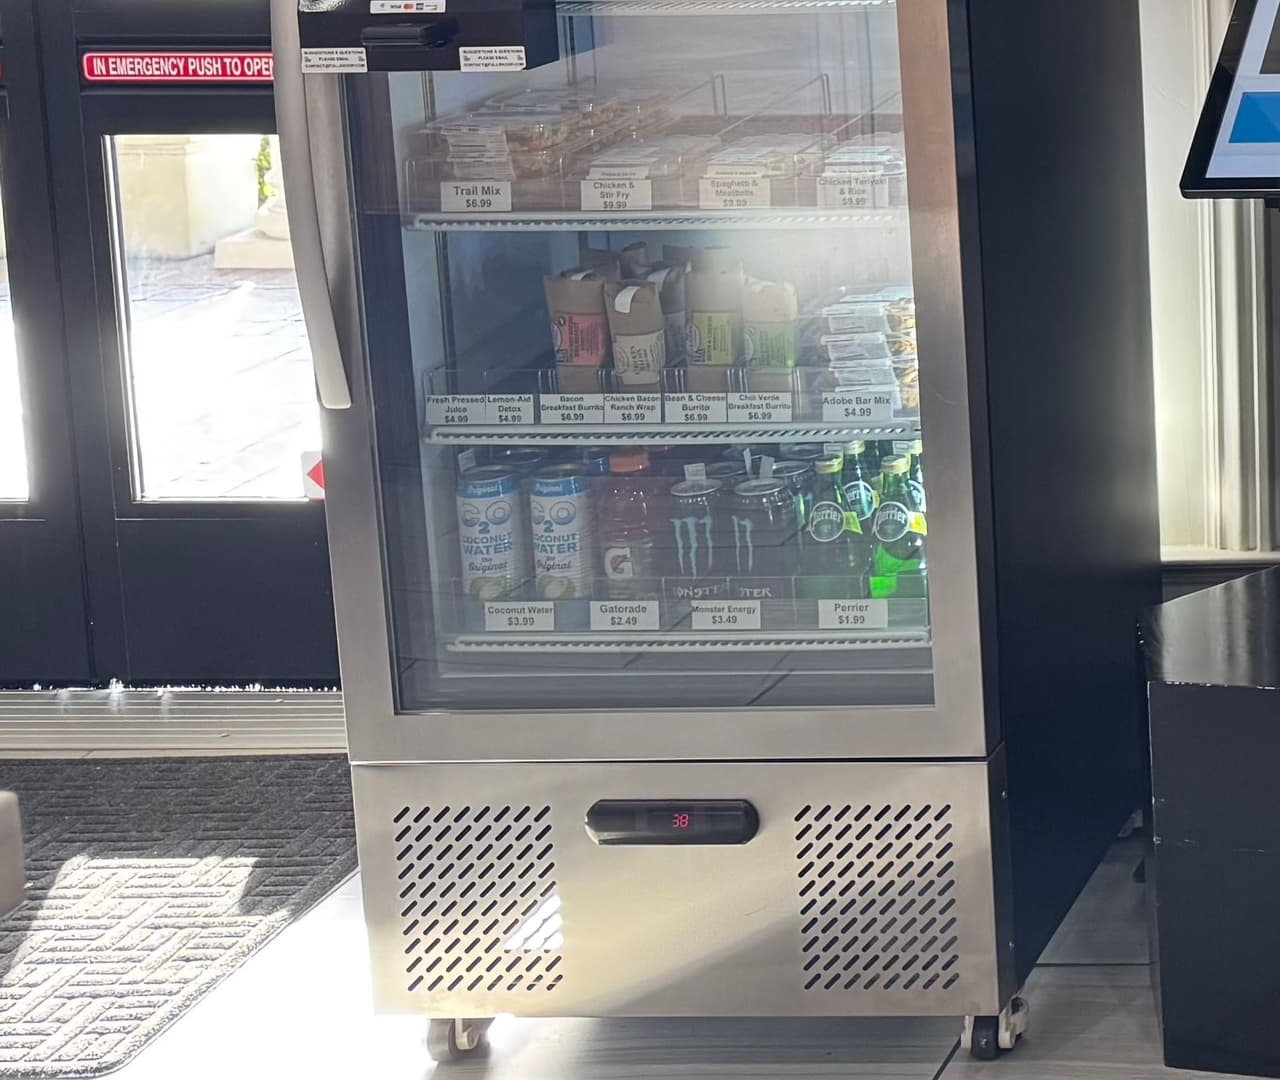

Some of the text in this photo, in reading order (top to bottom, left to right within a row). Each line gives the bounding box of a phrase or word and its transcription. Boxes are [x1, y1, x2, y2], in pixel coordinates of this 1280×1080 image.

[93, 57, 106, 75] IN
[109, 57, 185, 75] EMERGENCY
[188, 57, 223, 76] PUSH
[226, 58, 242, 76] TO
[454, 186, 501, 196] Trail Mix
[466, 198, 492, 208] $6.99
[823, 396, 890, 405] Adobe Bar Mix
[844, 408, 871, 417] $4.99
[463, 543, 512, 555] WATER
[487, 605, 553, 614] Coconut Water
[600, 604, 647, 615] Gatorade
[732, 605, 756, 615] Energy
[833, 602, 869, 612] Perrier
[507, 616, 535, 626] $3.99
[610, 615, 638, 626] $2.49
[711, 614, 738, 625] $3.49
[838, 615, 865, 625] $1.99
[673, 814, 689, 828] 38
